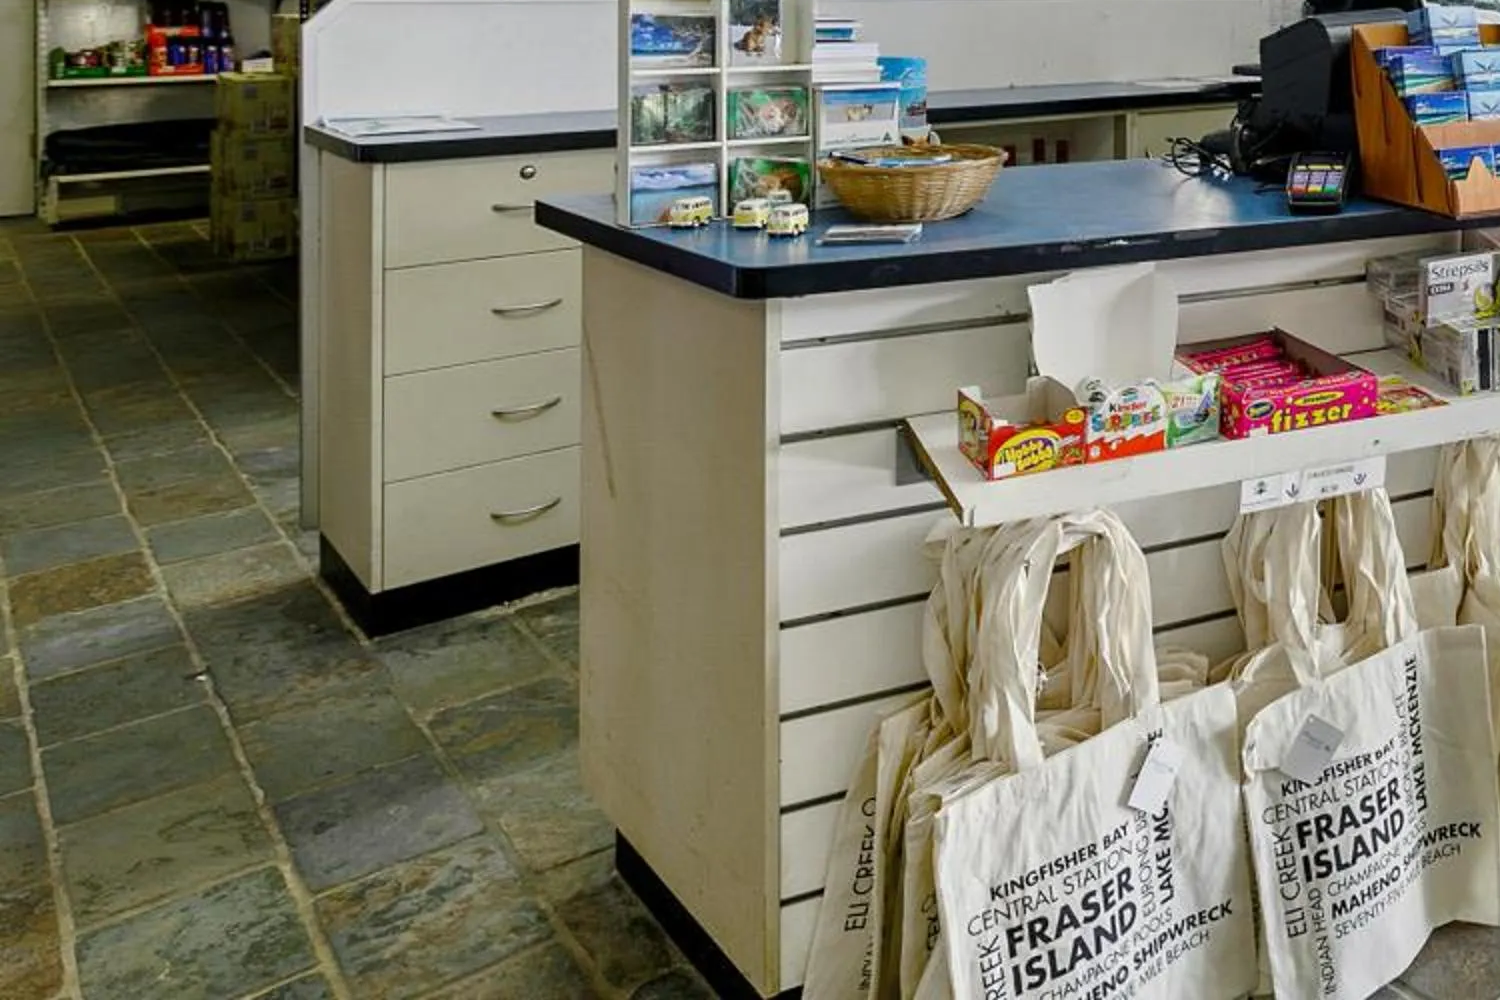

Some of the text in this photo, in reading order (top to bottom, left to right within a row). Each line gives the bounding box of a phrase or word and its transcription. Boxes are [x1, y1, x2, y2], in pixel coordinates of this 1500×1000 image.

[1431, 260, 1490, 282] Strepsils
[1109, 400, 1148, 413] Kinder
[1271, 403, 1353, 433] fizzer
[1404, 654, 1423, 756] MCKENZIE
[1261, 755, 1401, 826] CENTRAL STATION
[1295, 777, 1402, 849] FRASER
[989, 842, 1098, 902] KINGFISHER
[1102, 821, 1130, 851] BAY
[1135, 835, 1157, 919] EURONG
[1154, 846, 1175, 906] LAKE
[1300, 807, 1405, 883] ISLAND
[1327, 846, 1401, 898] CHAMPAGNE
[1420, 843, 1462, 870] BEACH
[966, 884, 1060, 938] CENTRAL
[1062, 839, 1137, 897] STATION
[1004, 866, 1135, 960] FRASER
[1271, 825, 1308, 940] ELI CREEK
[1330, 865, 1402, 920] MAHENO
[1010, 900, 1138, 998] ISLAND
[1132, 906, 1175, 951] POOLS
[1132, 897, 1234, 972] SHIPWRECK
[1165, 928, 1211, 964] BEACH
[1307, 886, 1338, 997] INDIAN HEAD
[979, 934, 1007, 1000] REEK
